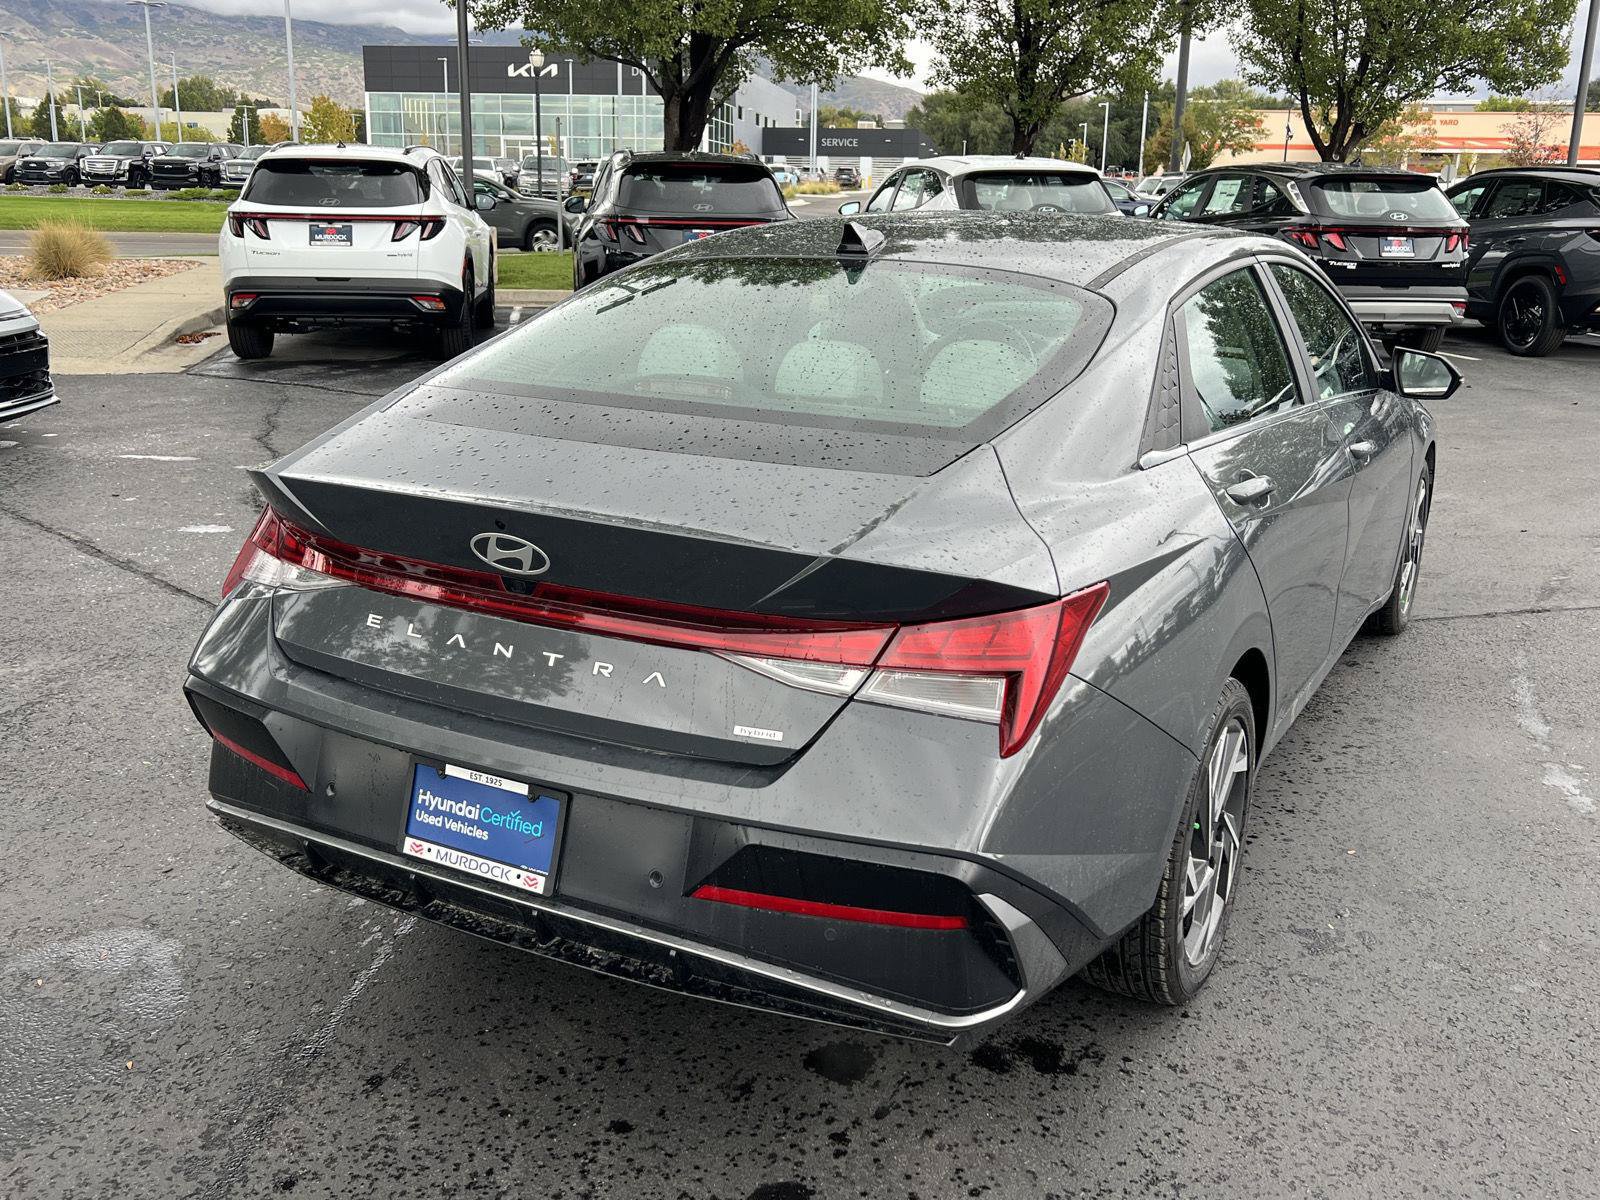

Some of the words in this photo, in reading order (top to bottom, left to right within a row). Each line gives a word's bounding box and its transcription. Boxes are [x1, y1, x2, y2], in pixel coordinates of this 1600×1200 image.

[821, 138, 859, 147] SERVICE
[366, 613, 666, 688] ELANTRA
[740, 727, 776, 738] hybrid
[469, 771, 485, 783] EST.
[485, 775, 503, 787] 1925
[415, 809, 443, 828] Used
[445, 815, 489, 841] Vehicles
[417, 788, 481, 821] Hyundai
[480, 806, 543, 838] Certified
[435, 848, 512, 882] MURDOCK
